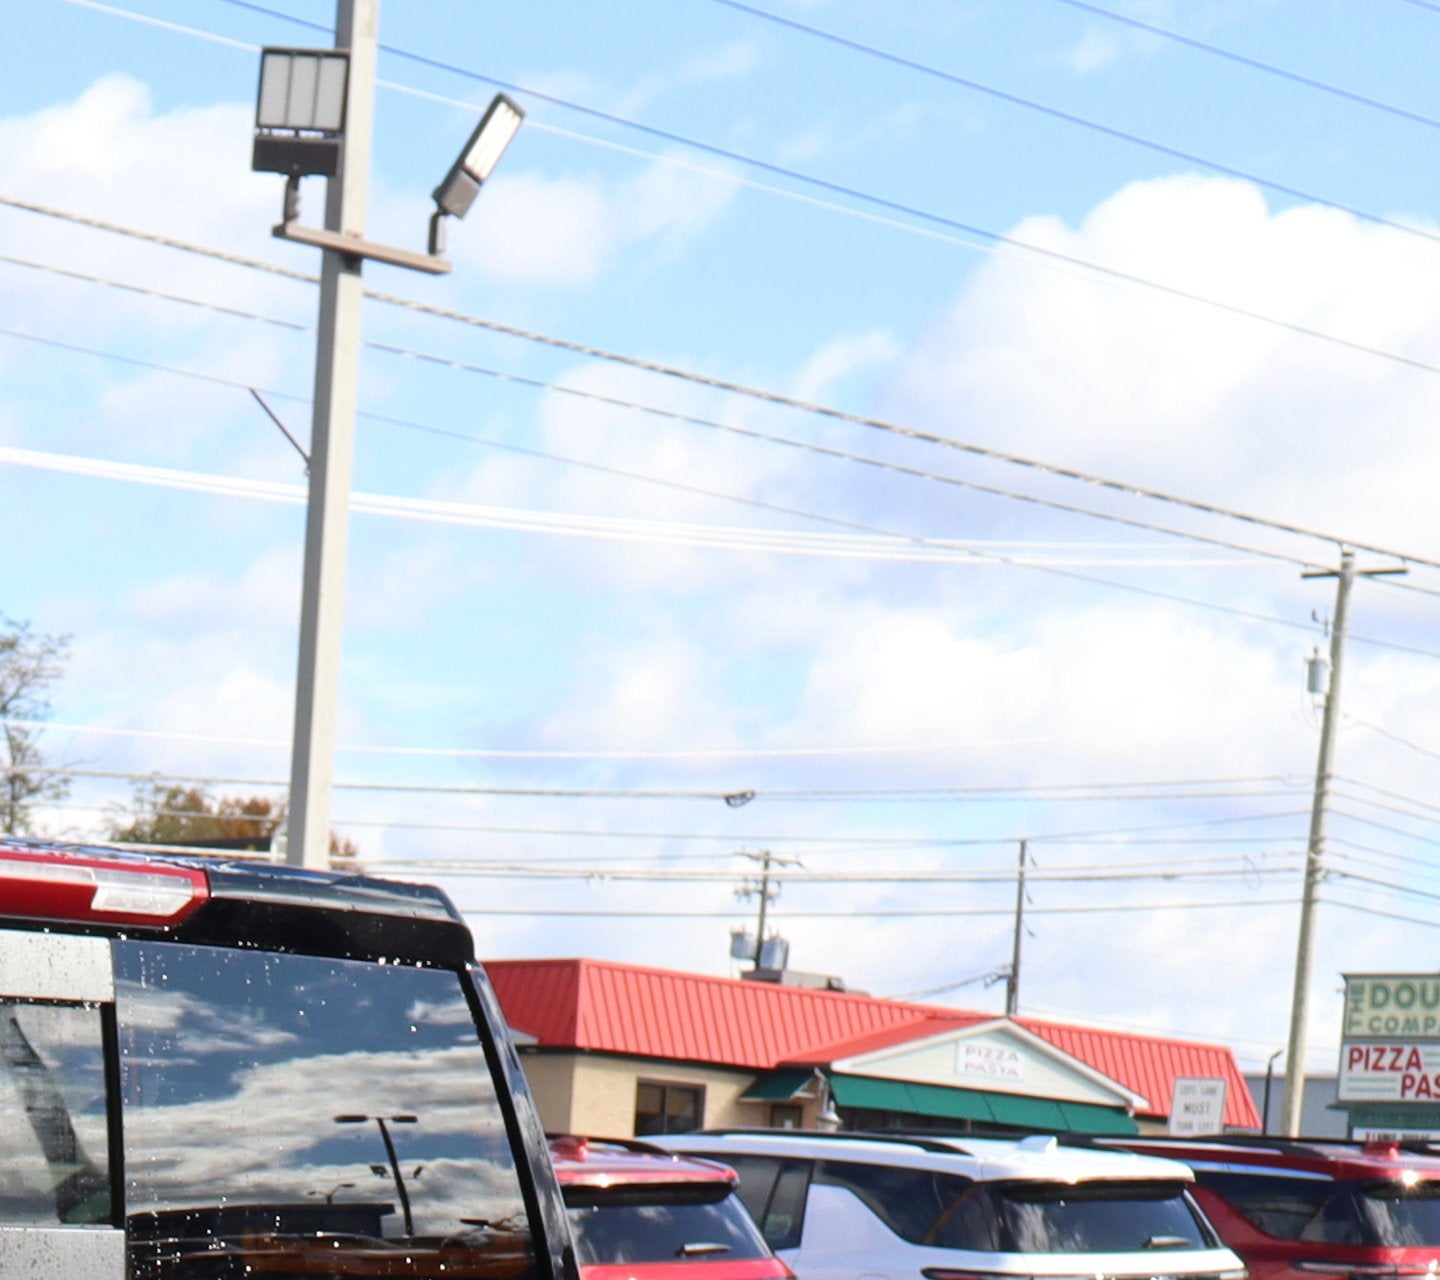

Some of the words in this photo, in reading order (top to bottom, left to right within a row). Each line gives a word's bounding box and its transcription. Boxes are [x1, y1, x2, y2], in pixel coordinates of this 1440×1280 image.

[1348, 982, 1365, 1032] THE
[965, 1045, 1019, 1062] PIZZA
[1348, 1046, 1423, 1072] PIZZA
[964, 1061, 1019, 1078] PASTA
